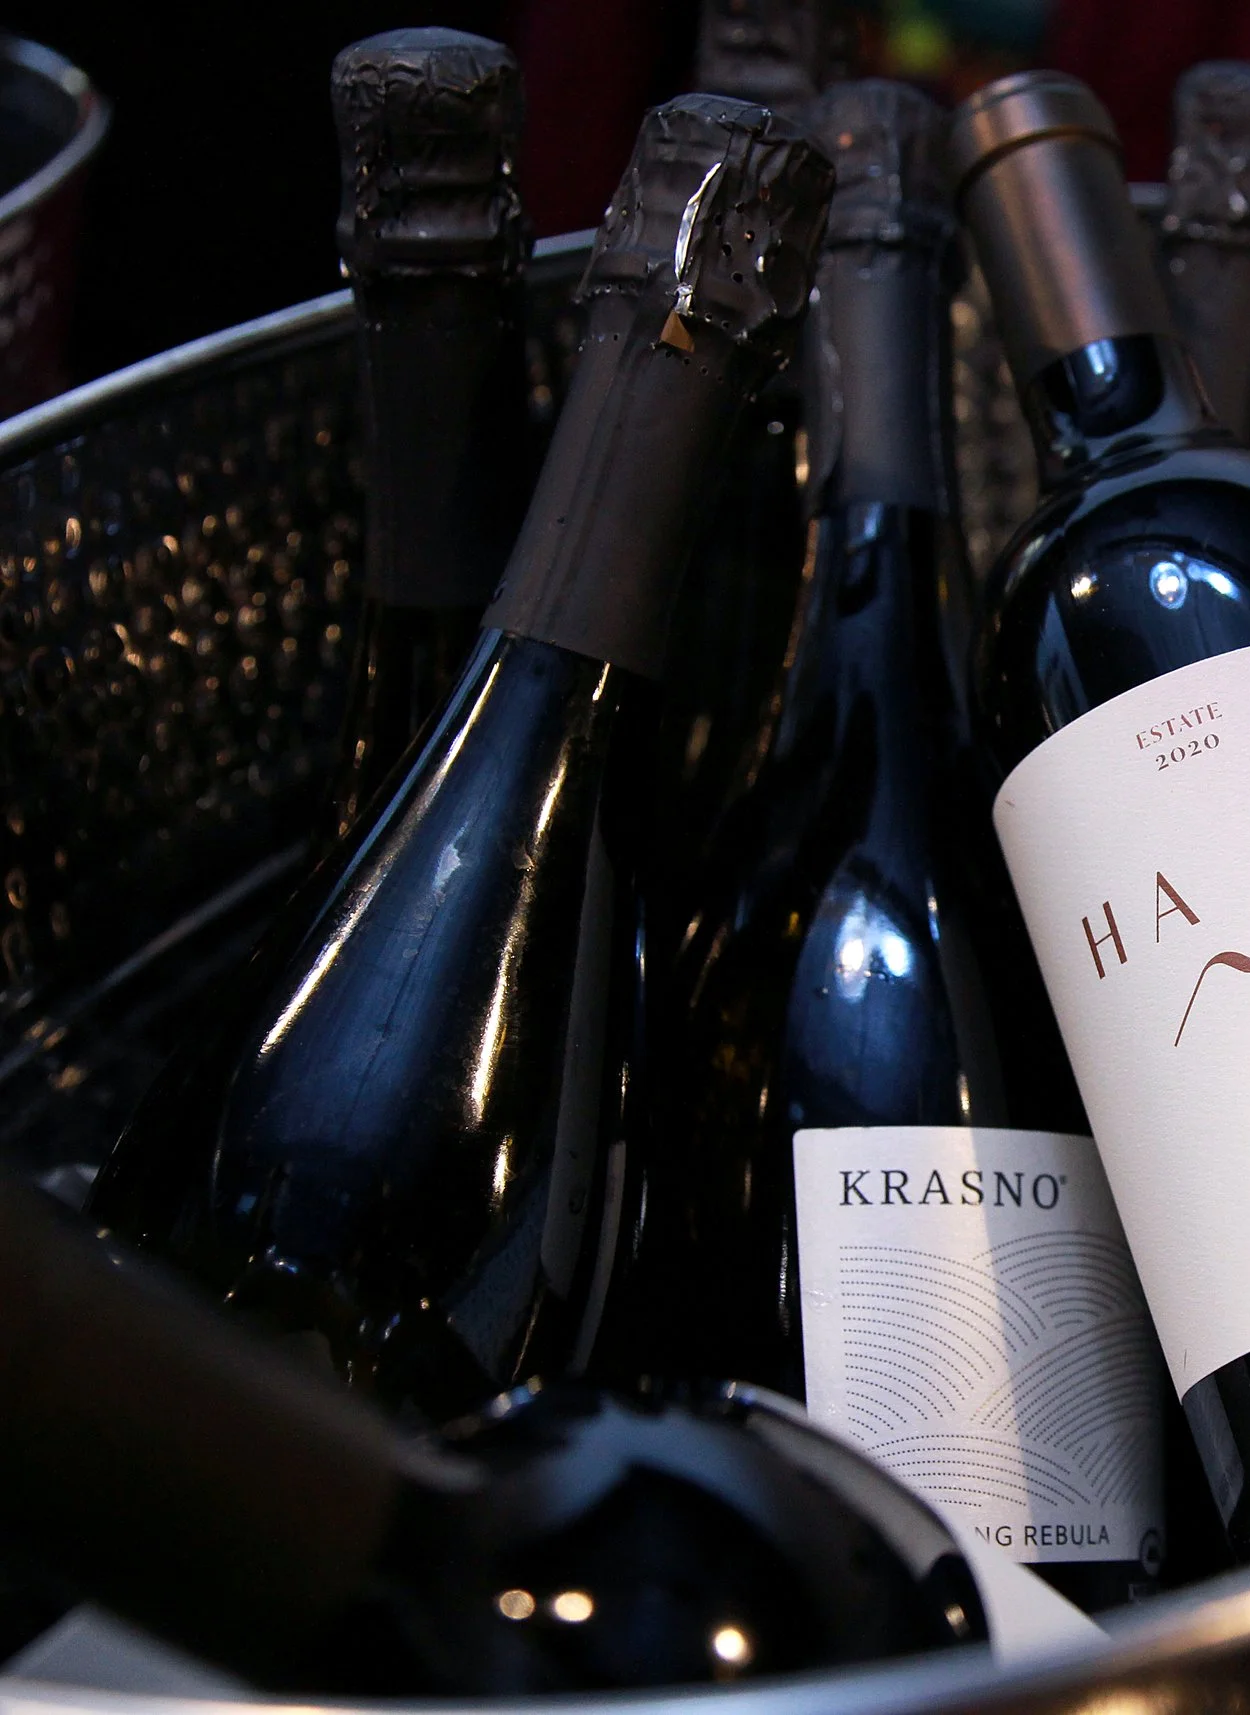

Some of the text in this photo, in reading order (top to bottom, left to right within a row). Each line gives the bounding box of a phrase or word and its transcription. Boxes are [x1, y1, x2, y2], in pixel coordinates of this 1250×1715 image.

[1136, 702, 1223, 750] ESTATE
[1155, 733, 1220, 771] 2020
[1024, 1525, 1110, 1546] REBULA
